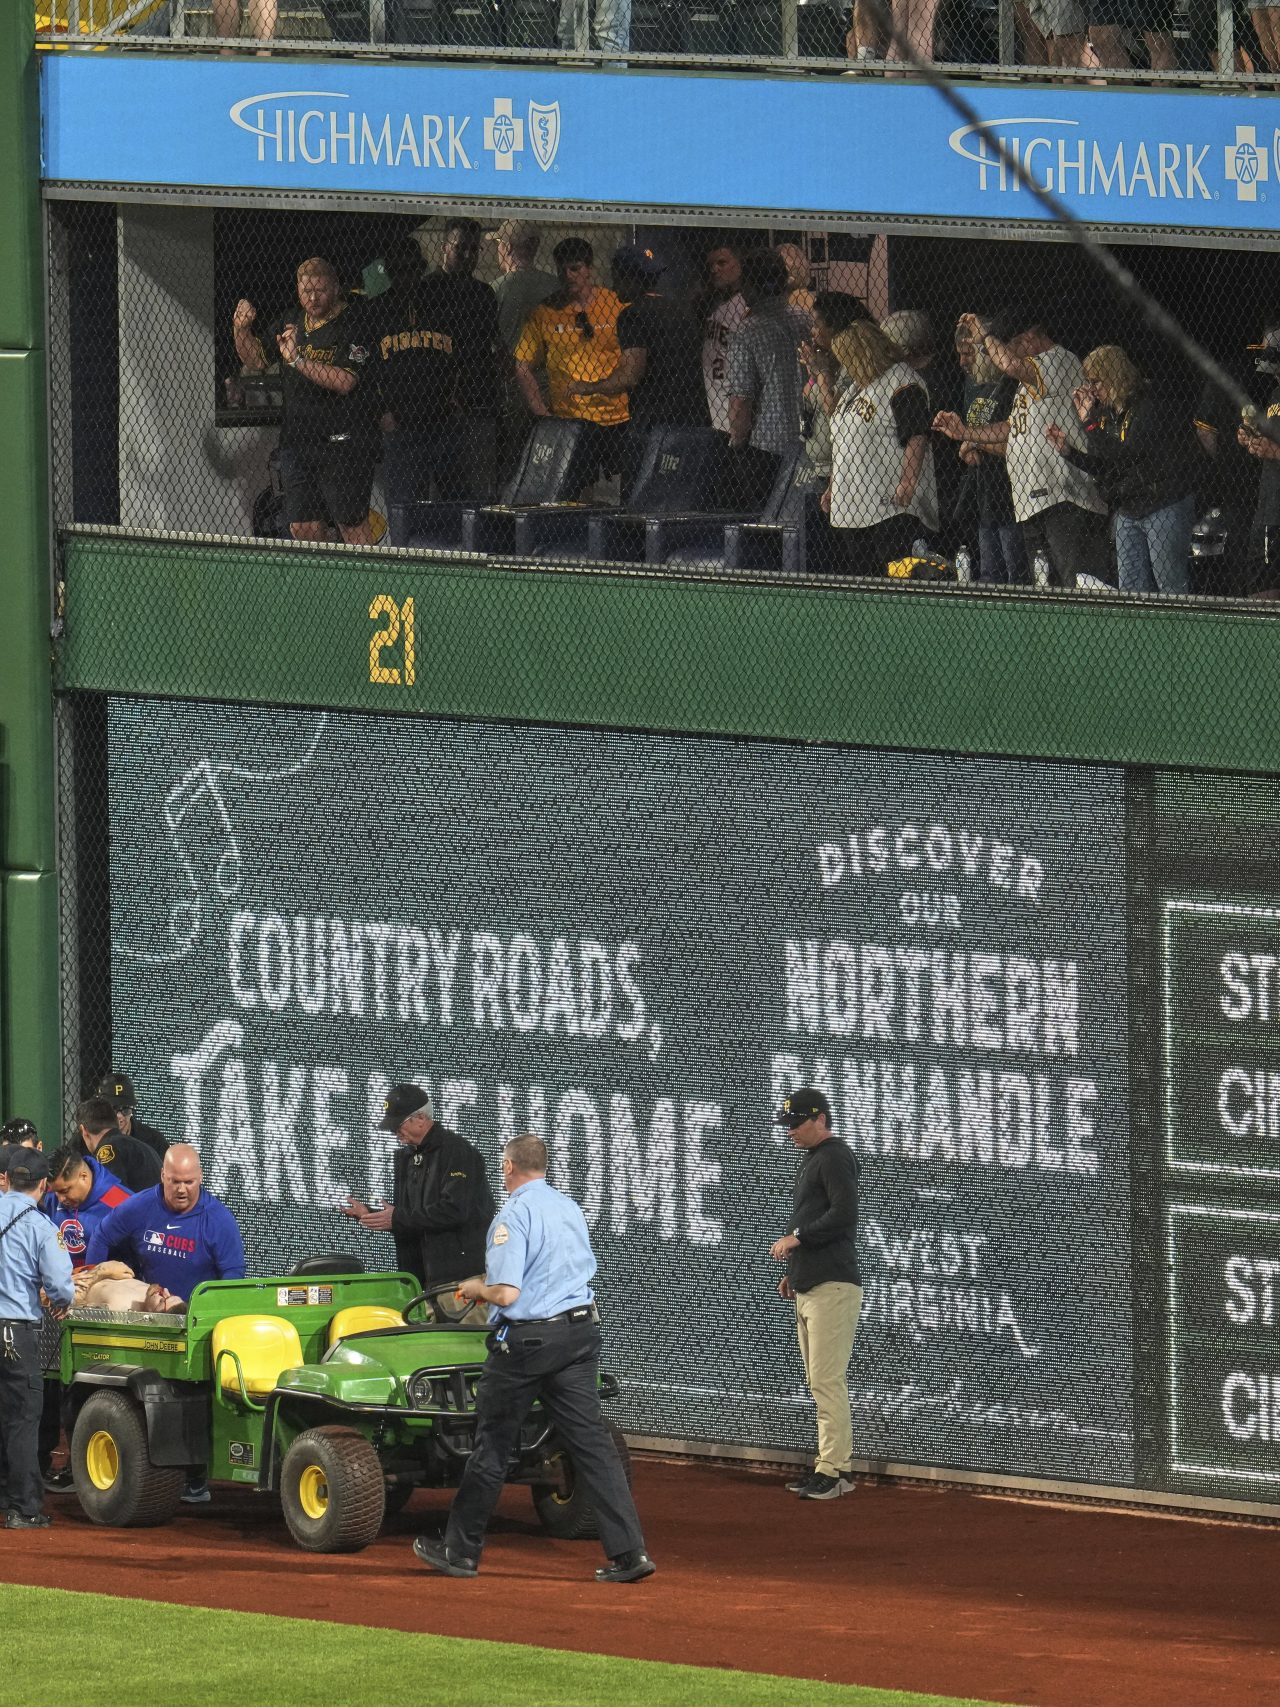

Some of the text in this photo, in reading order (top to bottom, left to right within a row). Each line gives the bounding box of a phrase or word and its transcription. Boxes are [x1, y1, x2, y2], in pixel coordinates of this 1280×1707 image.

[230, 91, 472, 170] HIGHMARK
[949, 118, 1213, 200] HIGHMARK
[380, 330, 454, 361] PIRATES
[368, 594, 416, 686] 21
[817, 822, 1045, 906] DISCOVER
[901, 891, 961, 928] OUR
[227, 908, 664, 1062] COUNTRY ROADS,
[783, 938, 1080, 1056] NORTHERN
[115, 1084, 123, 1096] P
[169, 1017, 352, 1210] TAKE
[147, 1244, 187, 1259] BASEBALL
[166, 1234, 195, 1252] CUBS
[864, 1216, 987, 1277] WEST
[92, 1352, 110, 1360] GATOR
[143, 1340, 179, 1353] JOHN DEERE
